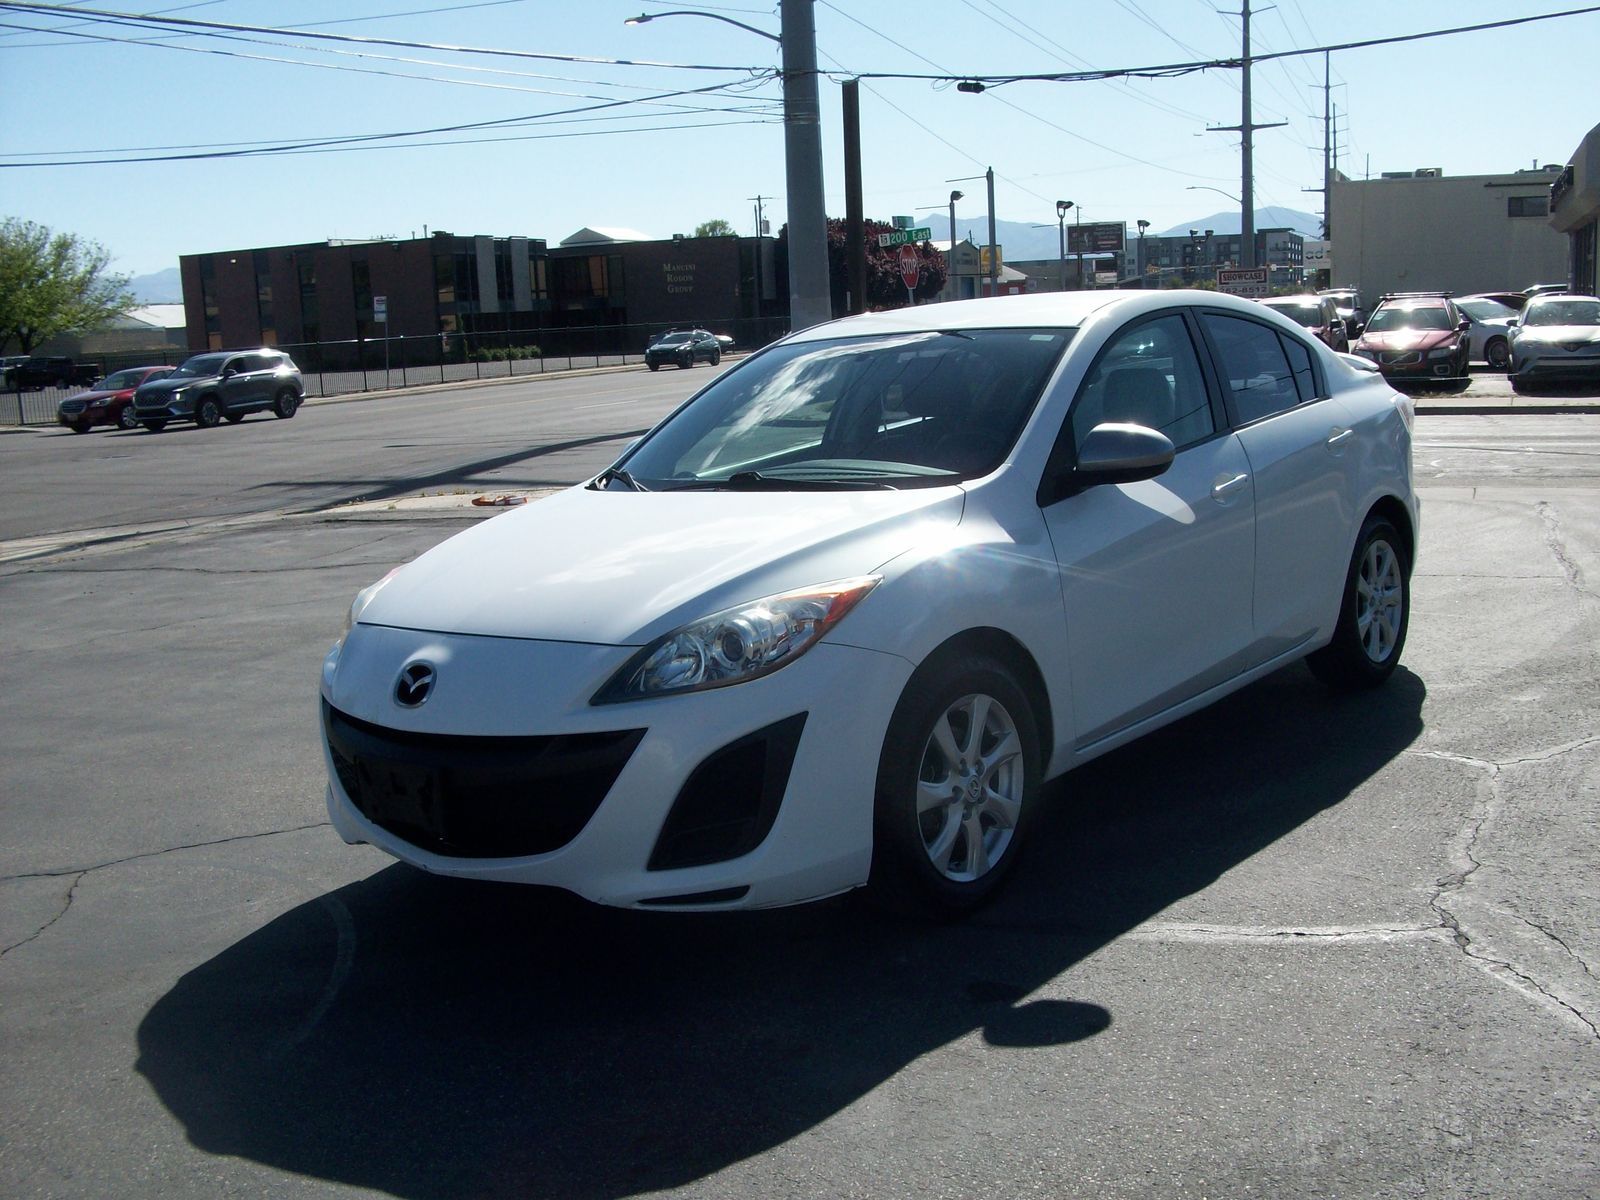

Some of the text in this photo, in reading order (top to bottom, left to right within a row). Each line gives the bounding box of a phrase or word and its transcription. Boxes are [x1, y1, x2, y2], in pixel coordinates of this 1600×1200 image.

[890, 231, 908, 244] 200
[912, 228, 930, 241] East
[901, 259, 917, 274] STOP
[1222, 272, 1263, 281] SHOWCASE
